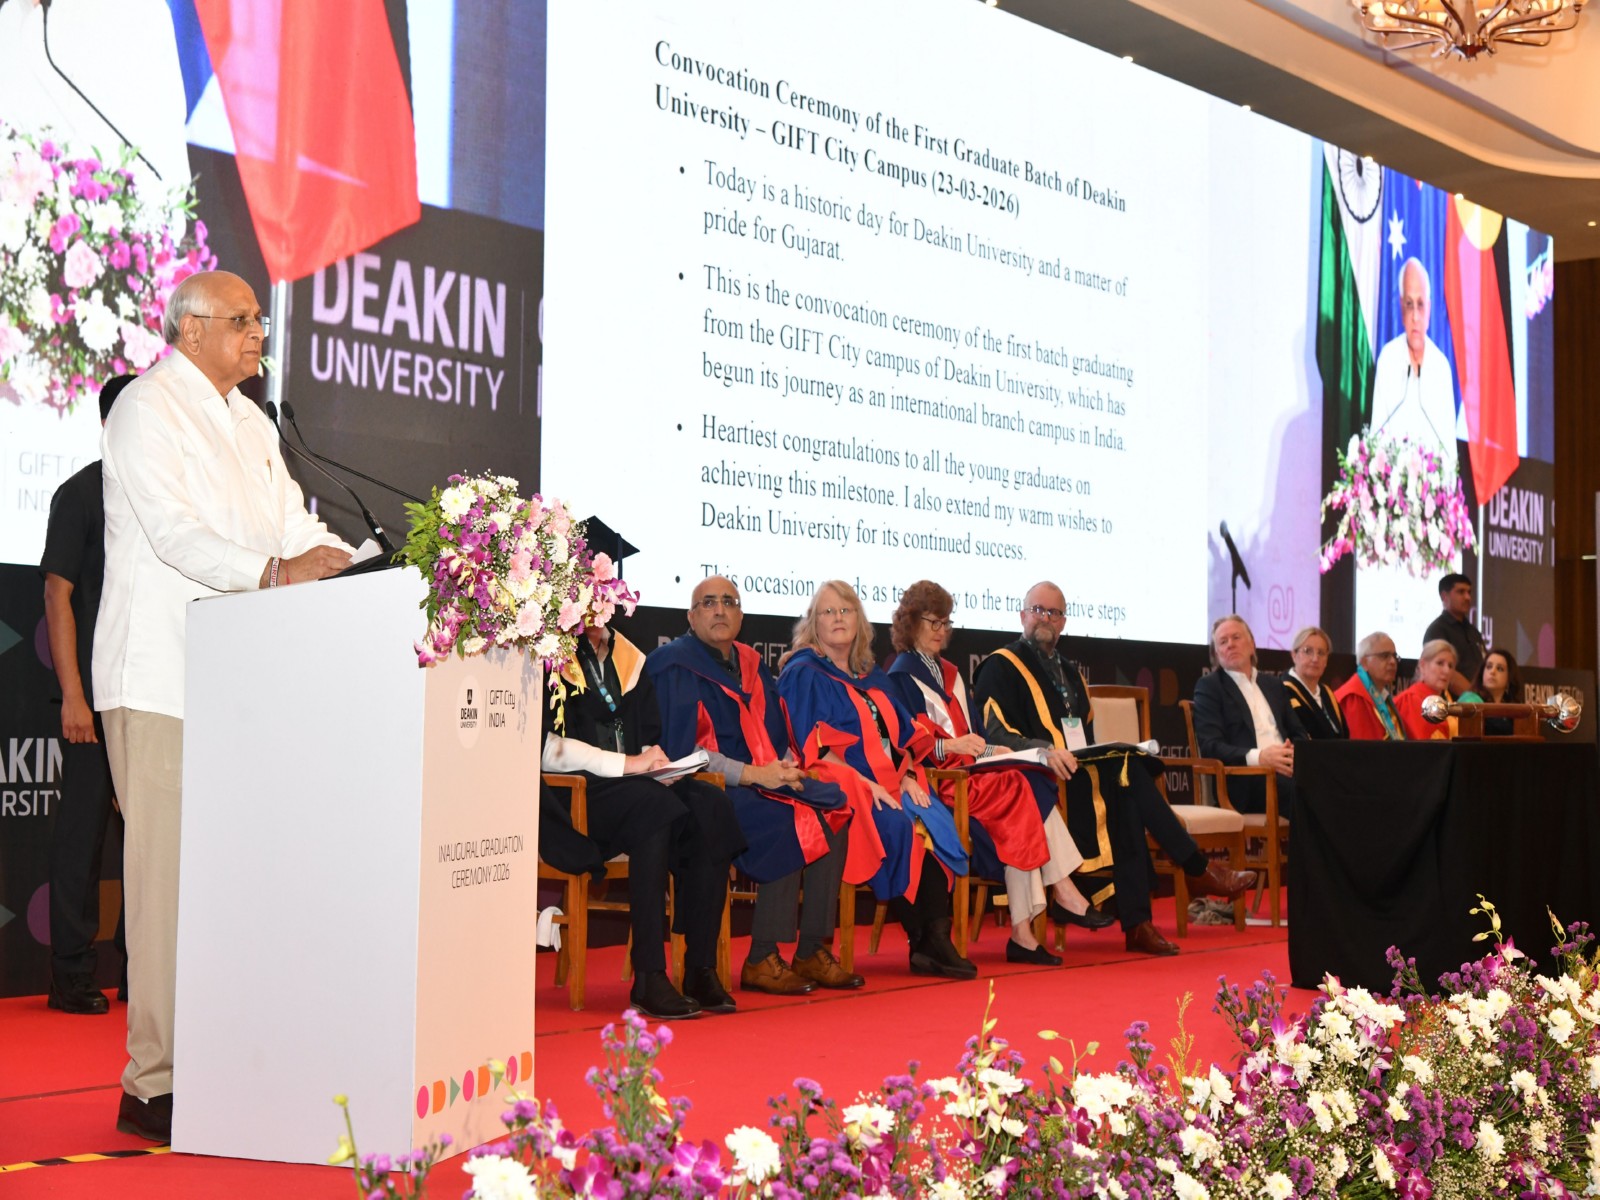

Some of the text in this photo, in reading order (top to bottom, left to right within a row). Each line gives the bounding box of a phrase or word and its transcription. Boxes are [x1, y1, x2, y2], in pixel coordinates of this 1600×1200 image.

[654, 39, 1126, 213] Convocation Ceremony of the First Graduate Batch of Deakin
[655, 82, 751, 141] University
[771, 119, 820, 156] GIFT
[823, 136, 859, 173] City
[863, 148, 928, 189] Campus
[931, 170, 1020, 219] (23-03-2026)
[703, 159, 1129, 297] Today is a historic day for Deakin University and a matter of
[703, 206, 845, 262] pride for Gujarat.
[313, 252, 507, 359] DEAKIN
[702, 263, 1134, 389] This is the convocation ceremony of the first batch graduating
[311, 333, 504, 412] UNIVERSITY
[703, 307, 1127, 417] from the GIFT City campus of Deakin University, which has
[701, 350, 1126, 452] begun its journey as an international branch campus in India.
[19, 451, 65, 478] GIFT
[701, 413, 1091, 496] Heartiest congratulations to all the young graduates on
[700, 459, 783, 500] achieving
[787, 469, 817, 497] this
[821, 474, 899, 507] milestone.
[913, 486, 943, 513] also
[945, 495, 991, 519] extend
[994, 504, 1015, 528] my
[1018, 508, 1054, 527] warm
[1057, 508, 1098, 533] wishes
[1101, 517, 1113, 535] to
[1489, 484, 1544, 536] DEAKIN
[700, 501, 1027, 561] Deakin University for its continued success.
[1488, 531, 1544, 566] UNIVERSITY
[743, 570, 815, 597] occasion
[872, 584, 888, 603] as
[964, 591, 978, 610] to
[982, 588, 1002, 611] the
[1097, 604, 1127, 626] steps
[460, 707, 478, 720] DEAKIN
[488, 712, 506, 728] INDIA
[489, 689, 516, 710] GIFT City
[1163, 771, 1190, 792] NDIA
[438, 834, 524, 863] INAUGURAL GRADUATION
[451, 863, 510, 889] CEREMONY 2026
